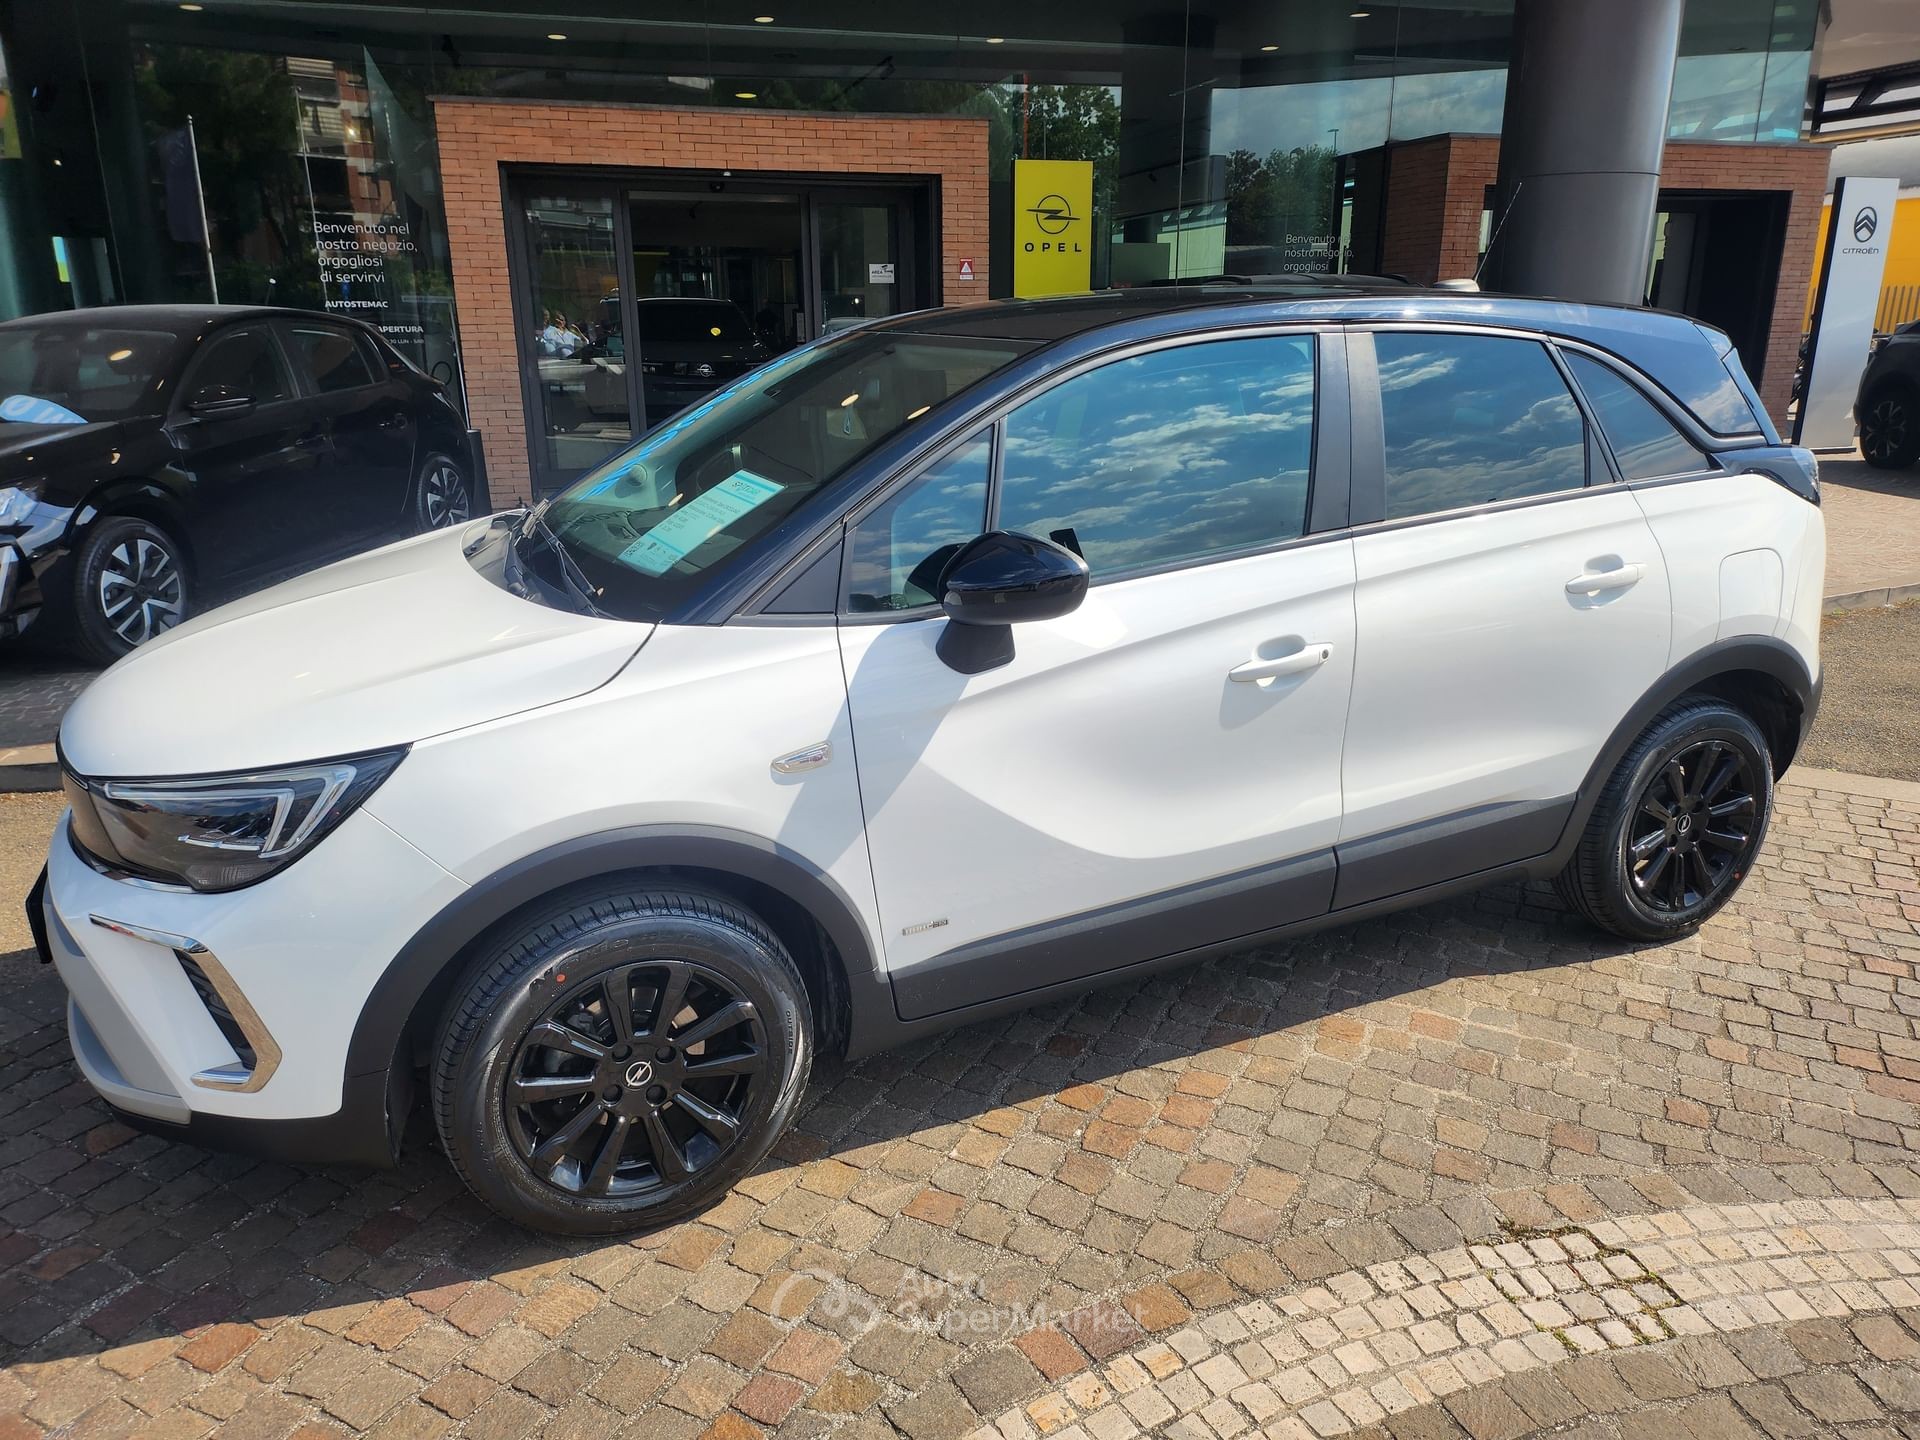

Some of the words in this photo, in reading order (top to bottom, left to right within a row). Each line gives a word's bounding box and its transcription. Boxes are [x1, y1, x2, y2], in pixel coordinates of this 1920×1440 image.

[313, 221, 386, 234] Benvenuto
[390, 223, 410, 235] nel
[1285, 233, 1336, 244] Benvenuto
[315, 239, 359, 250] nostro
[363, 240, 418, 253] negozio,
[1024, 242, 1082, 252] OPEL
[1842, 247, 1880, 255] CITROËN
[1284, 248, 1315, 258] nostro
[1316, 248, 1354, 260] negoio,
[317, 254, 383, 269] orgogliosi
[1283, 260, 1329, 274] orgogliosi
[320, 271, 332, 283] di
[336, 271, 385, 283] servirvi
[324, 300, 389, 308] AUTOSTEMAC
